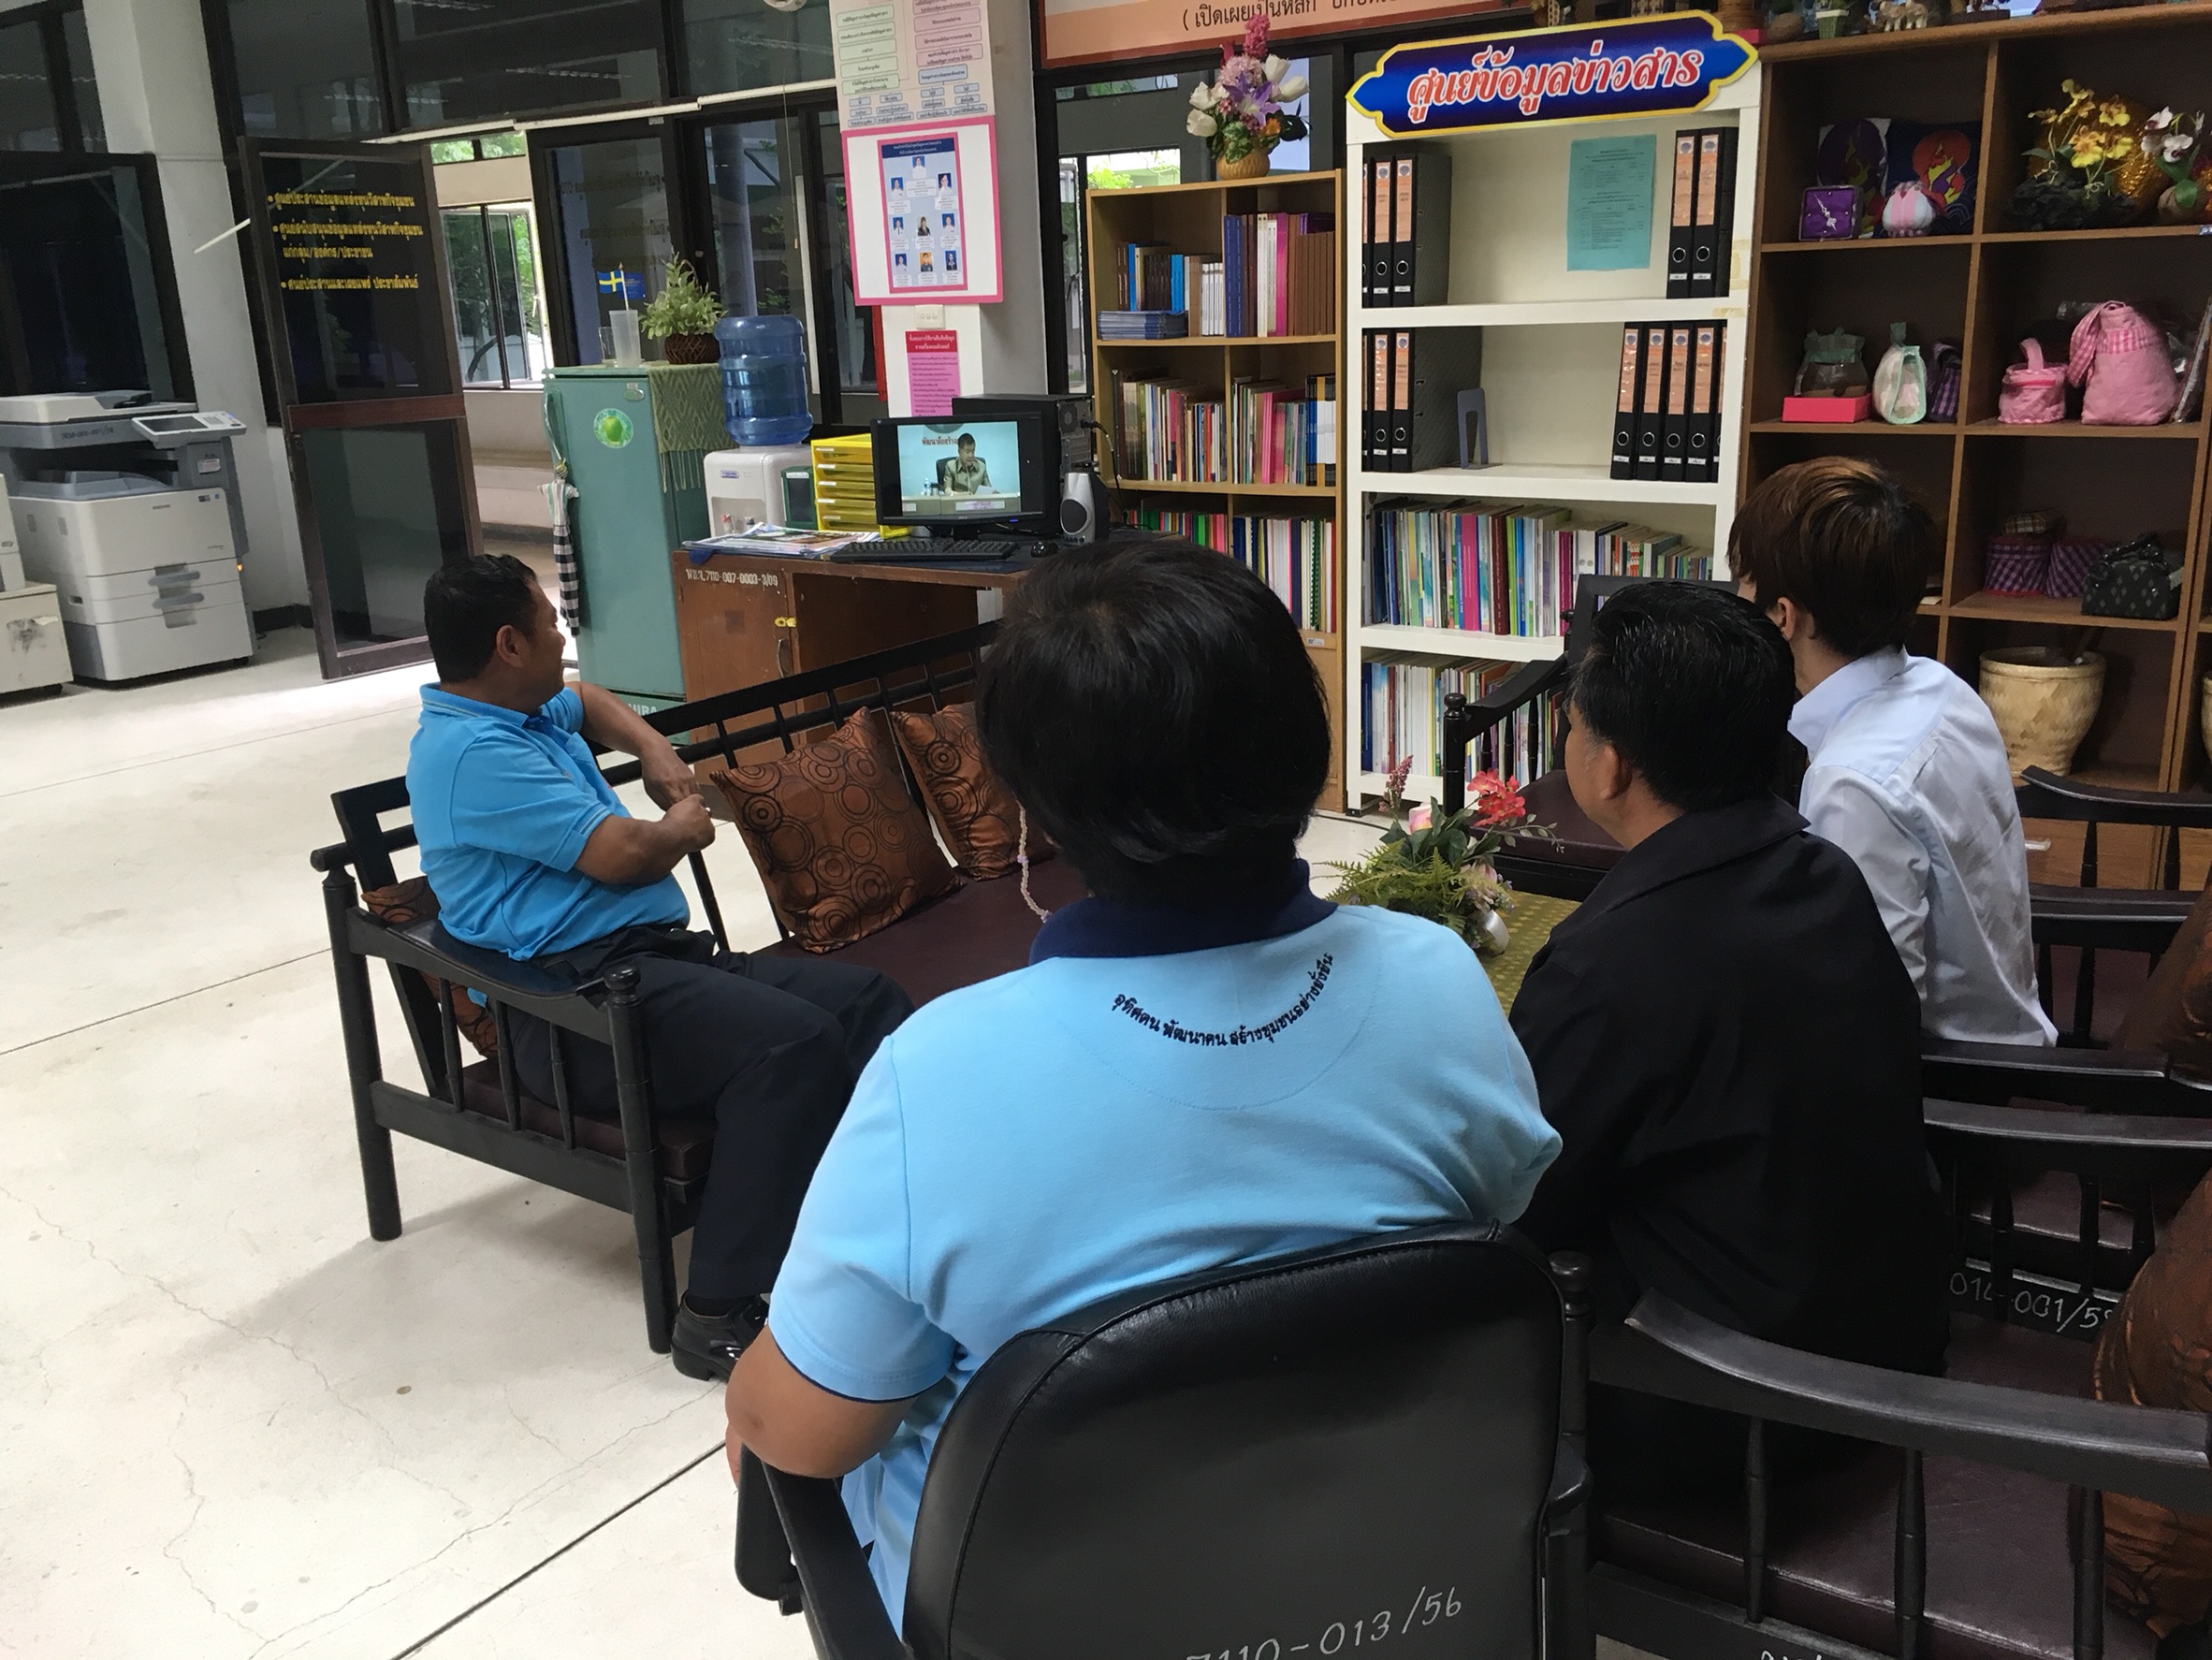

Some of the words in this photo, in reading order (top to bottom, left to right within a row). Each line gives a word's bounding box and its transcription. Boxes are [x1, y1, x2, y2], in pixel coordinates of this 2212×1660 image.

[1406, 40, 1704, 124] ศูนย์ข้อมูลข่าวสาร
